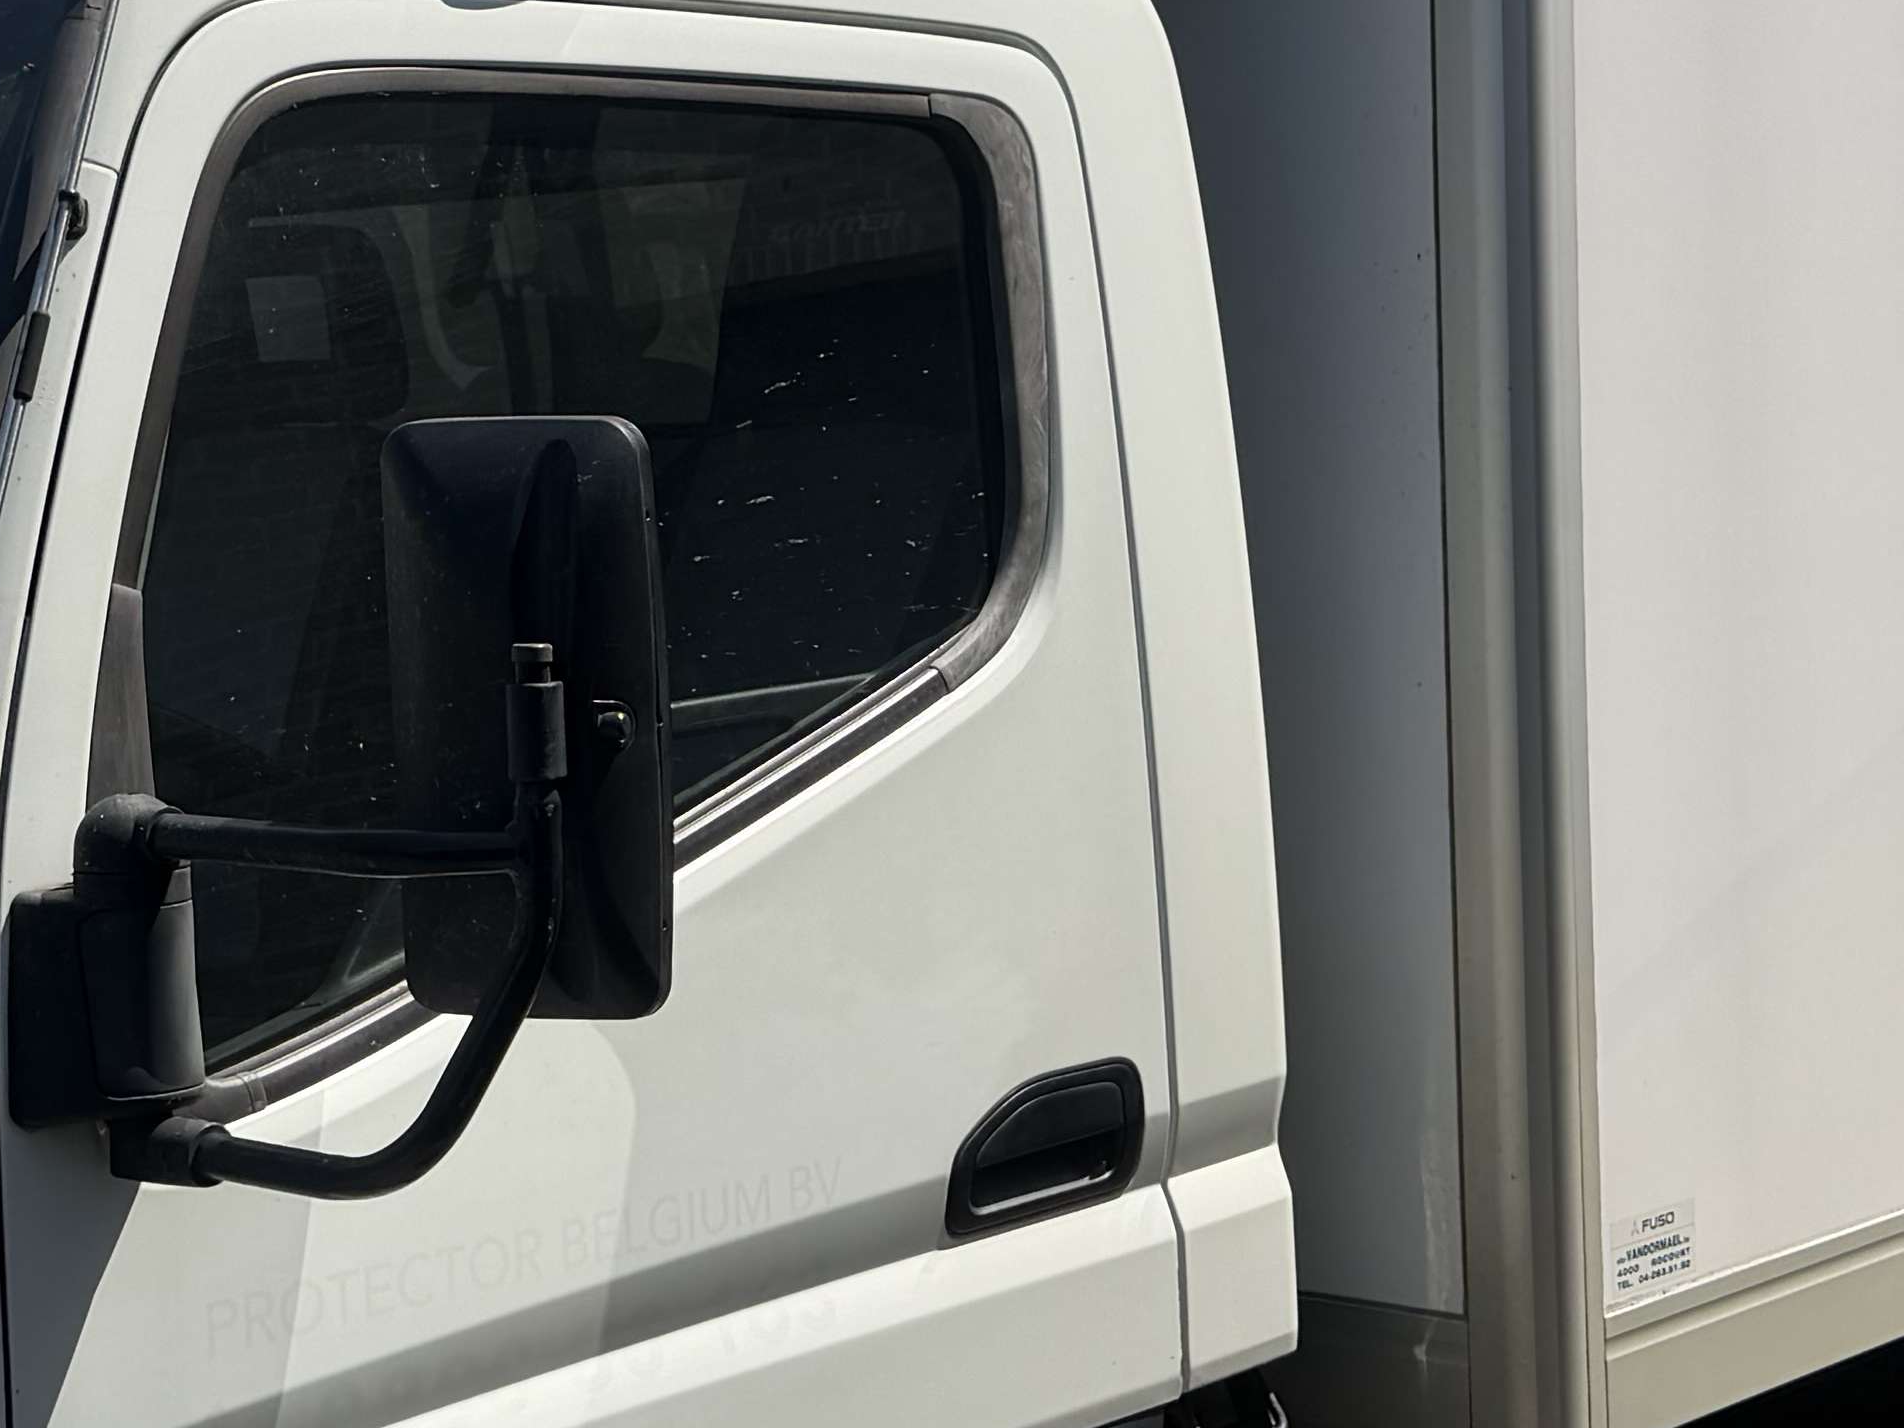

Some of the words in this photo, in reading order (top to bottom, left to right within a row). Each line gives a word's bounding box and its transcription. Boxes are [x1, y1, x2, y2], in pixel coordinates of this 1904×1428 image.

[203, 1226, 545, 1359] PROTECTOR
[560, 1173, 773, 1269] BELGIUM
[786, 1155, 844, 1210] BV
[1640, 1211, 1675, 1233] FUSO
